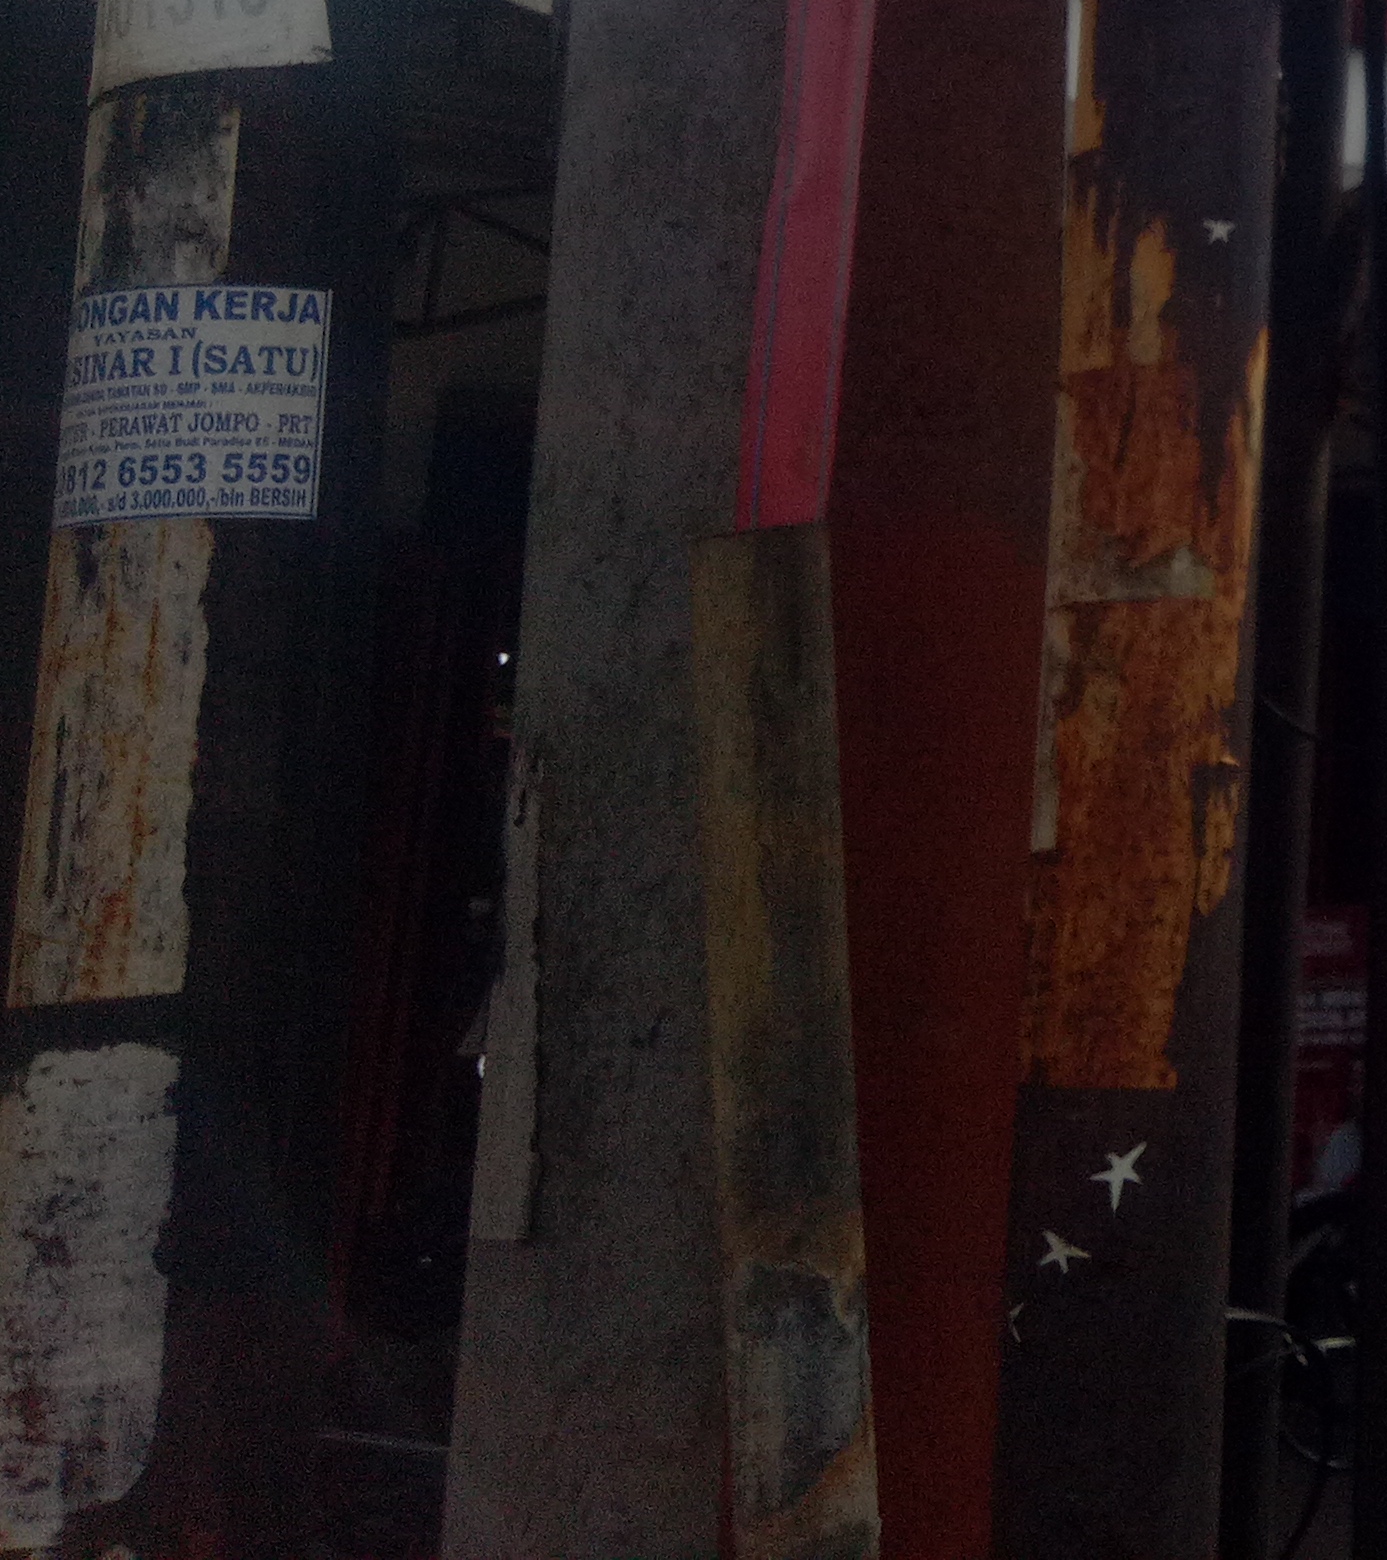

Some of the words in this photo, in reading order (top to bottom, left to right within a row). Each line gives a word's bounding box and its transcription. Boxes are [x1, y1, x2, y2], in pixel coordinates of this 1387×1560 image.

[194, 289, 321, 325] KERJA
[93, 326, 197, 347] YAYASAN
[72, 347, 156, 386] SINAR
[191, 340, 320, 383] (SATU)
[99, 413, 183, 438] PERAWAT
[187, 412, 261, 433] JOMPO
[278, 414, 313, 435] PRT
[118, 452, 207, 488] 6553
[221, 452, 312, 484] 5559
[249, 487, 306, 508] BERSIH
